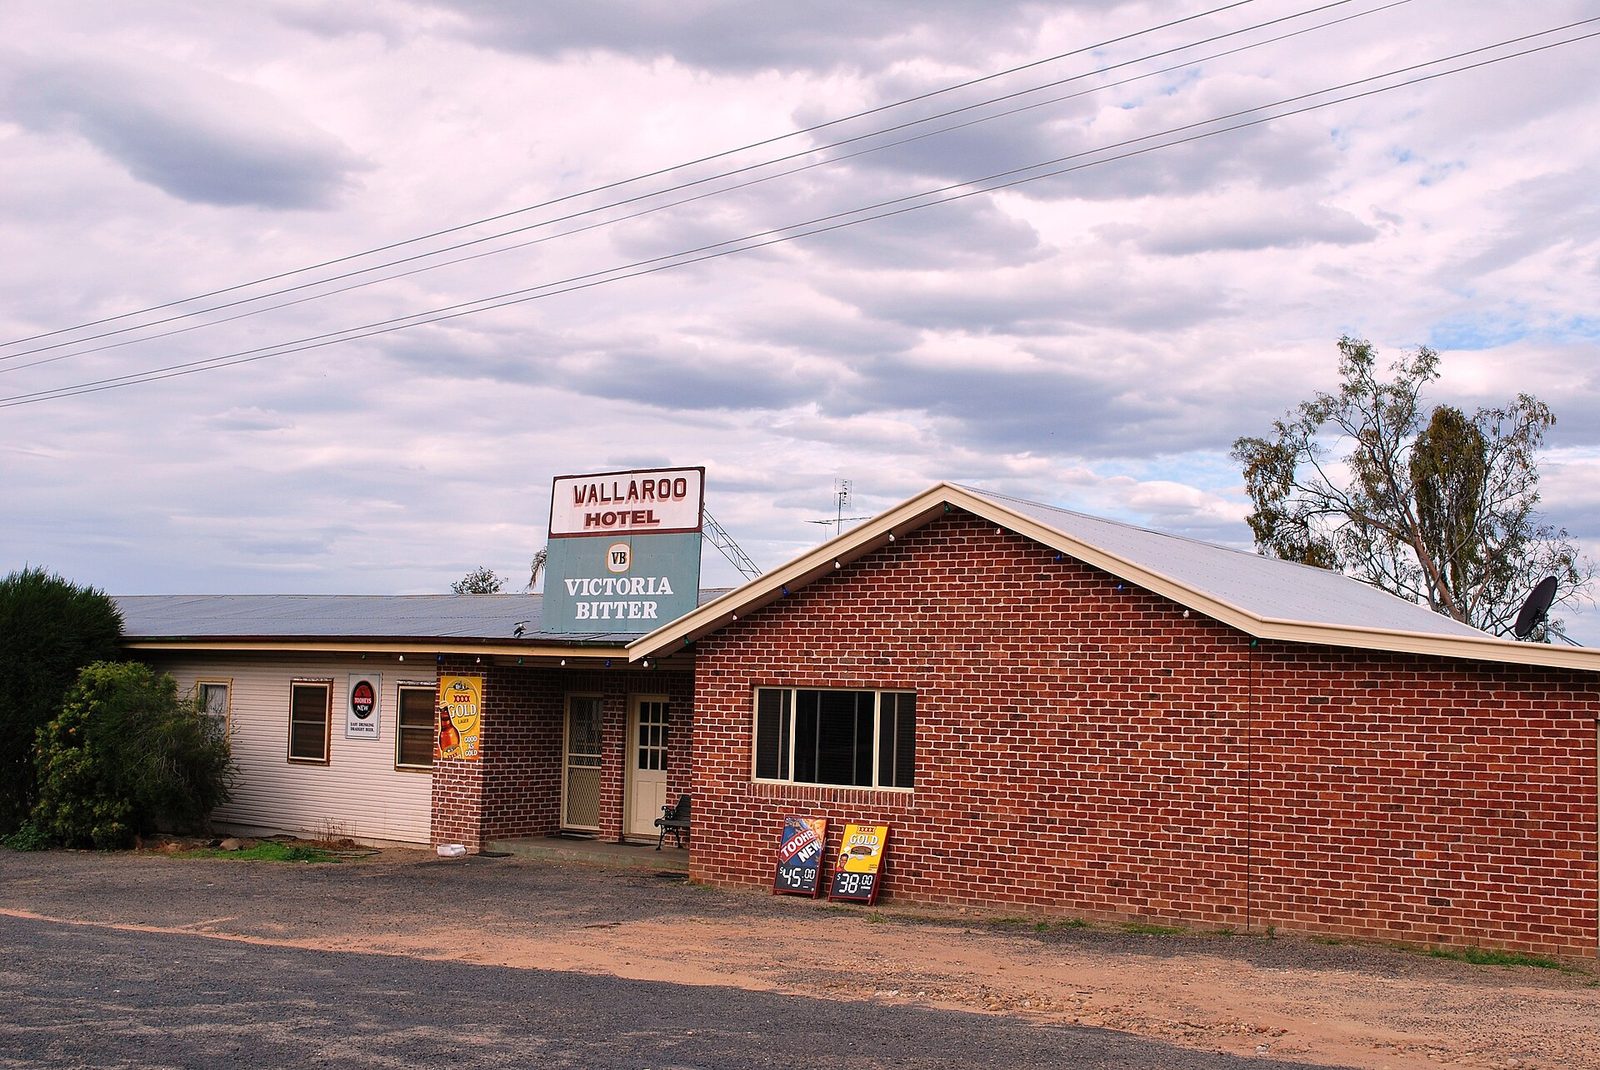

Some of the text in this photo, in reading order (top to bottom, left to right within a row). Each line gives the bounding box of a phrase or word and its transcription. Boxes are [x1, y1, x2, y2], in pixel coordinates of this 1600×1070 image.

[574, 478, 687, 505] WALLAROO
[585, 510, 660, 528] HOTEL
[611, 551, 627, 565] VB
[564, 577, 674, 596] VICTORIA
[575, 601, 658, 620] BITTER
[453, 694, 471, 703] XXXX
[448, 704, 477, 718] GOLD
[849, 834, 878, 845] GOLD
[797, 840, 821, 863] NEW
[780, 867, 816, 888] $45.00
[837, 873, 873, 894] $38.00
